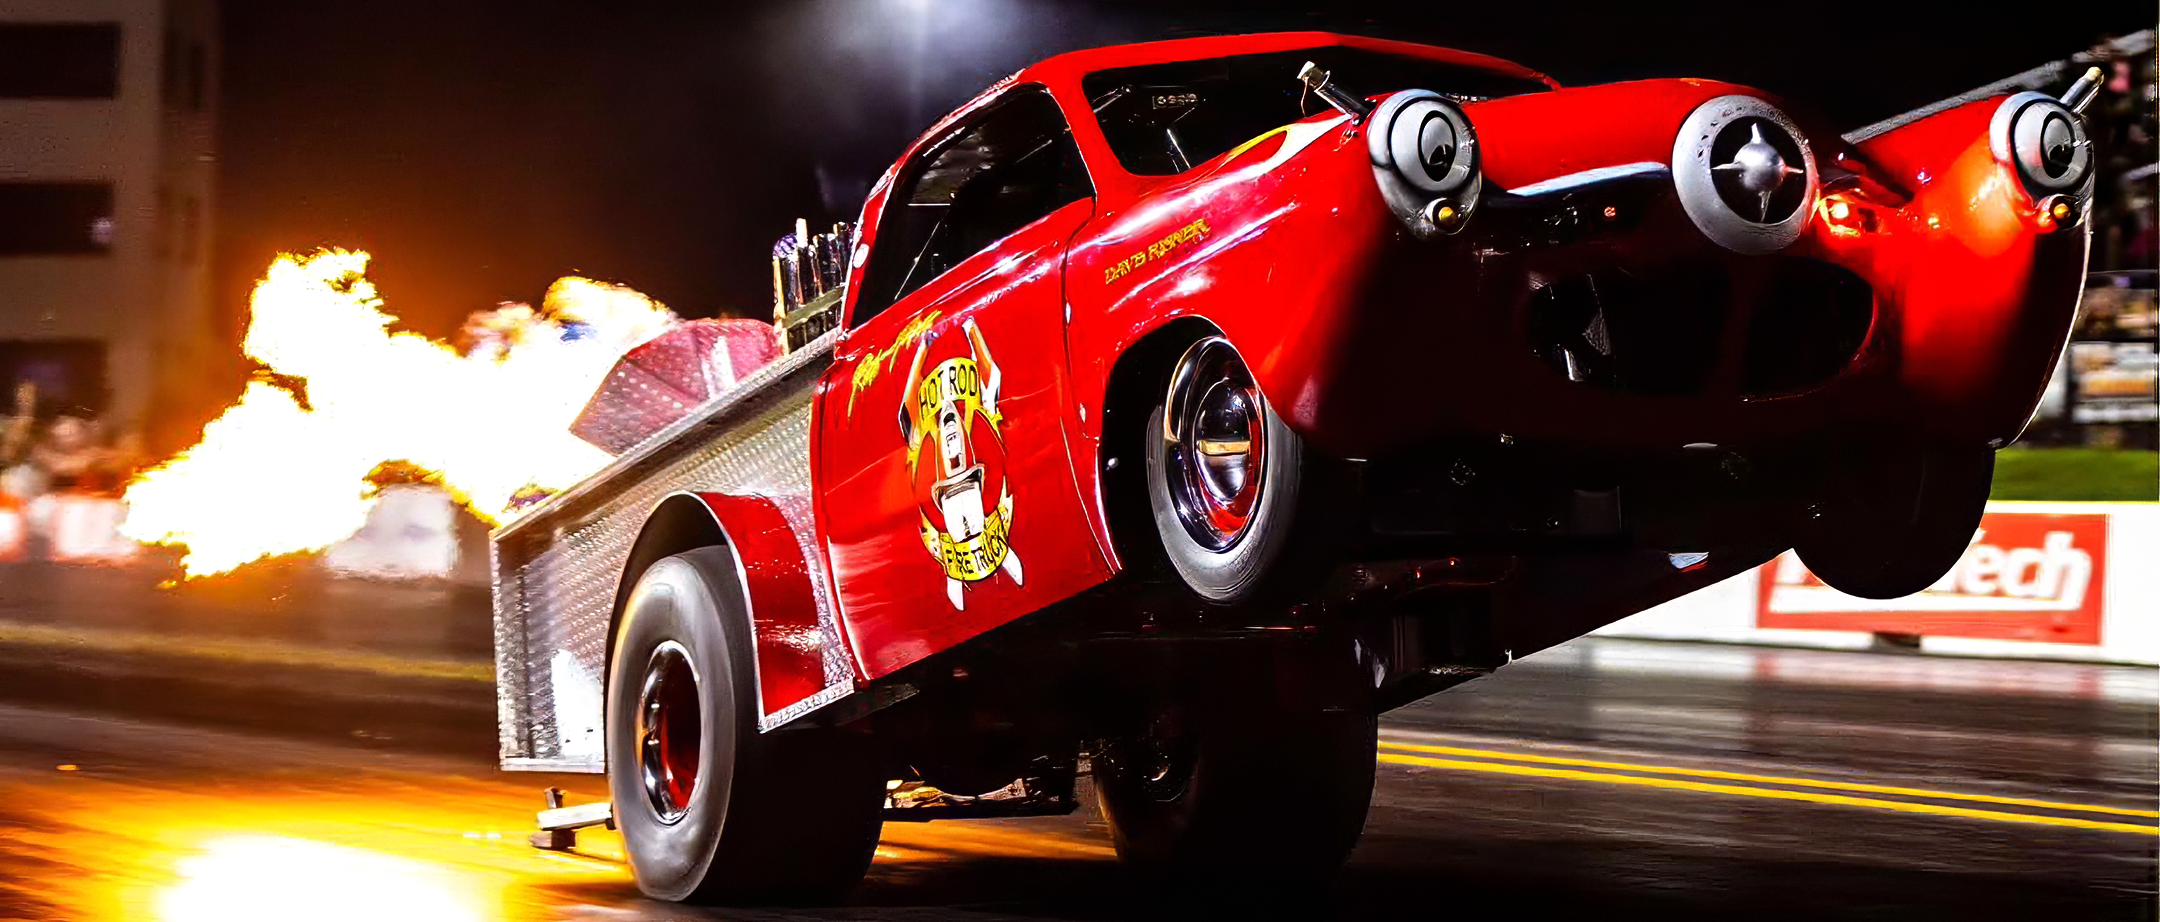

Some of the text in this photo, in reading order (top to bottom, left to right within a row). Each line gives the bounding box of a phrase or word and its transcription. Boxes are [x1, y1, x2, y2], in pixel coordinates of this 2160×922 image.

[919, 368, 945, 421] HOT
[949, 363, 978, 397] ROD
[970, 527, 1008, 572] TRUCK
